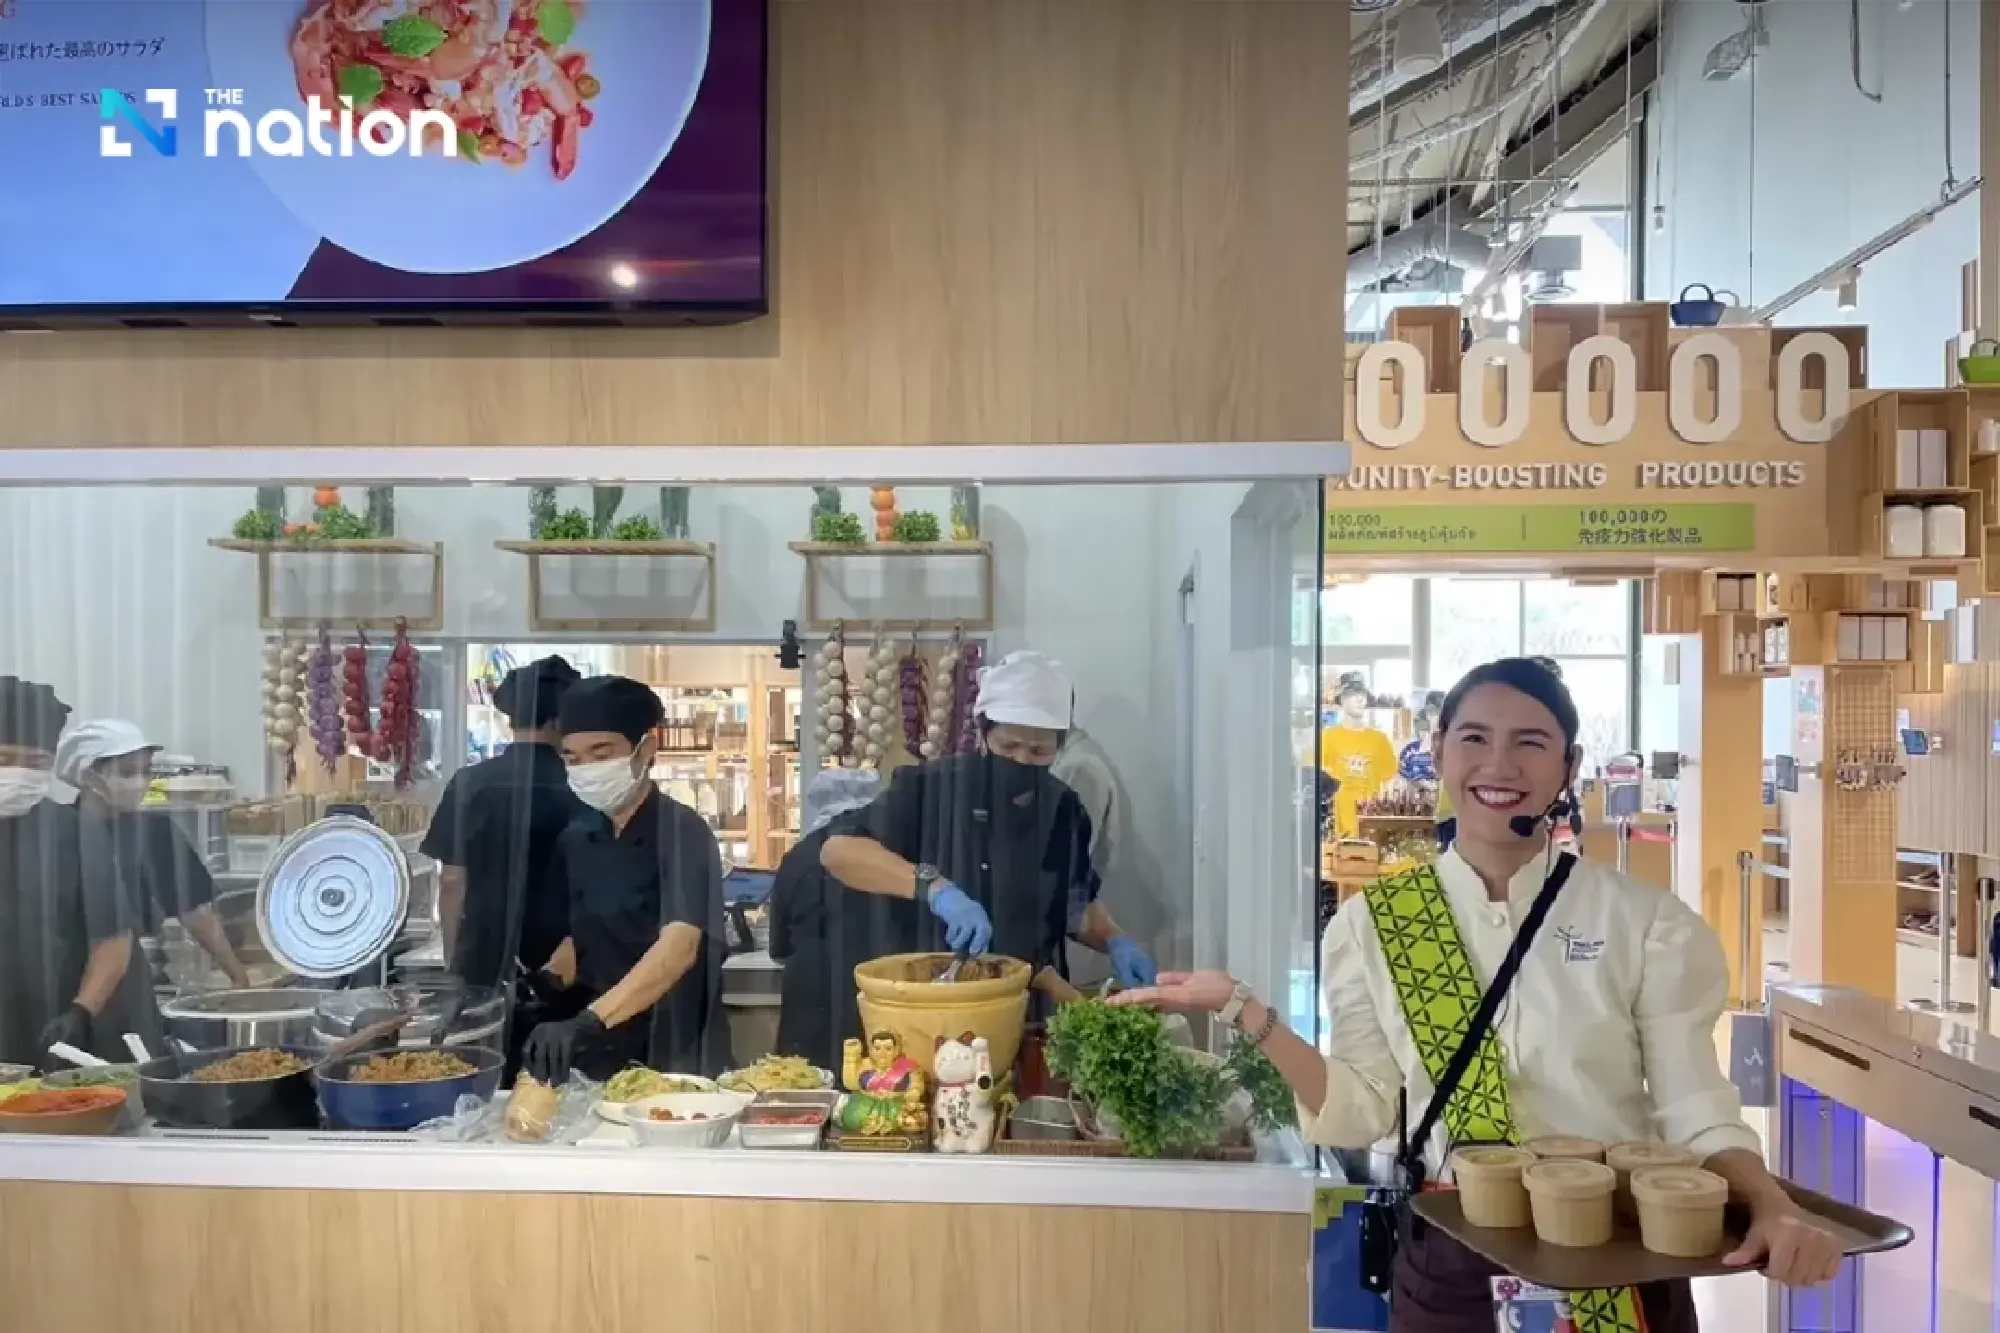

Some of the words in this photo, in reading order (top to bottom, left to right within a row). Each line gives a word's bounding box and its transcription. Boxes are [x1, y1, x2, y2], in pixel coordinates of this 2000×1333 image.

[40, 93, 74, 107] BEST
[1335, 462, 1608, 490] UNITY-BOOSTING
[1638, 460, 1807, 487] PRODUCTS
[1328, 514, 1381, 527] 100,000
[1580, 509, 1668, 526] 100,000の
